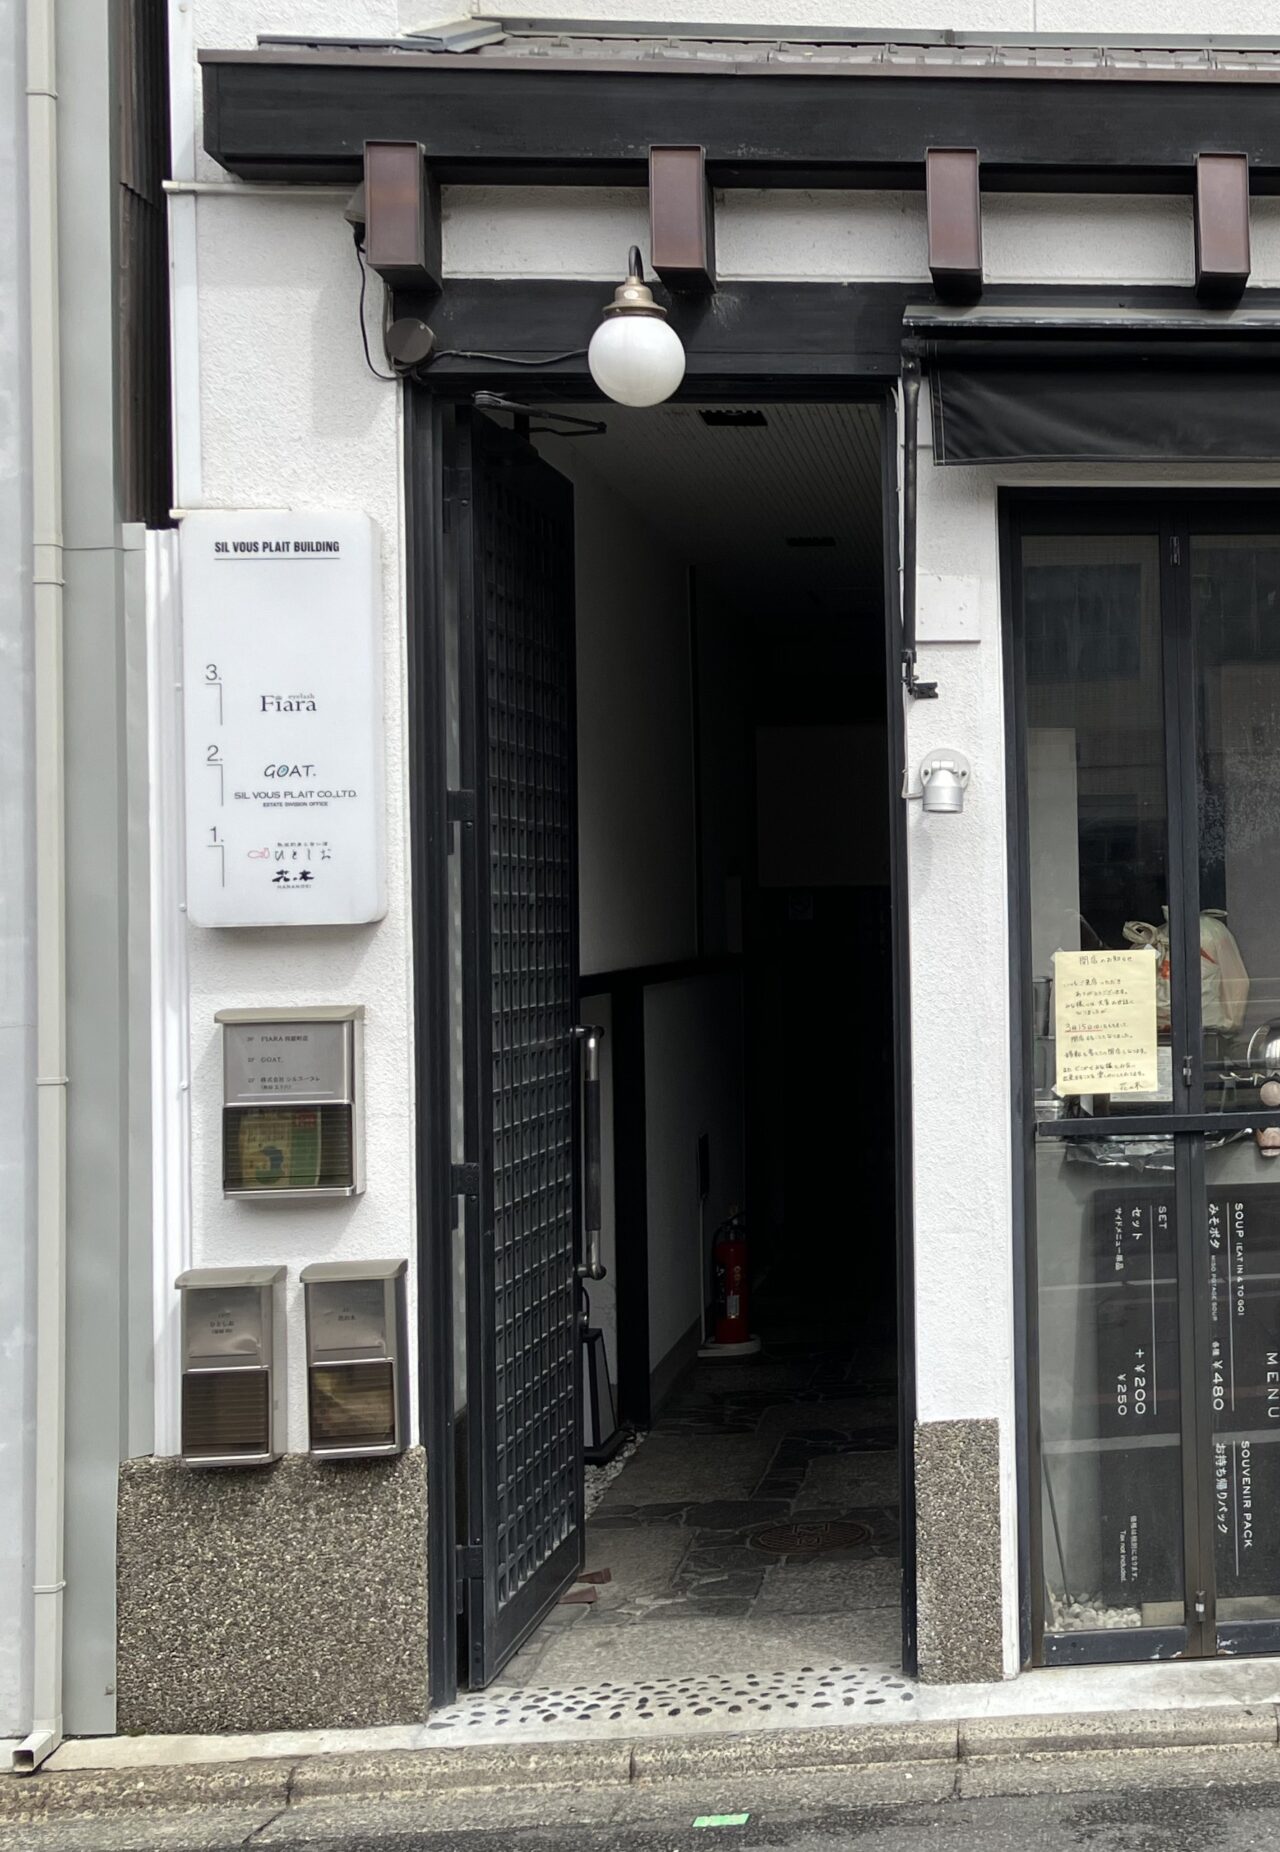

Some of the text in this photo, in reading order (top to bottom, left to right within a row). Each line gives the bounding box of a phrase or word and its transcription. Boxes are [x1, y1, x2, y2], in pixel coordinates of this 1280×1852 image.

[214, 541, 340, 553] SIL VOUS PLAIT BUILDING
[205, 663, 222, 681] 3.
[260, 694, 317, 712] Fiara
[206, 744, 223, 762] 2.
[264, 764, 317, 778] GOAT.
[252, 791, 281, 799] VOUS
[283, 790, 314, 799] PLAIT
[1079, 955, 1133, 966] 閉店のお知らせ
[1131, 1207, 1143, 1241] セット
[1158, 1206, 1167, 1229] SET
[1208, 1203, 1220, 1249] みそポタ
[1234, 1202, 1244, 1239] SOUP
[1237, 1285, 1244, 1297] TO
[1117, 1373, 1127, 1416] ¥250
[1212, 1360, 1224, 1411] ¥480
[1265, 1352, 1280, 1418] MENU
[1215, 1442, 1229, 1534] お持ち帰りパック
[1241, 1440, 1253, 1548] SOUVENIR PACK
